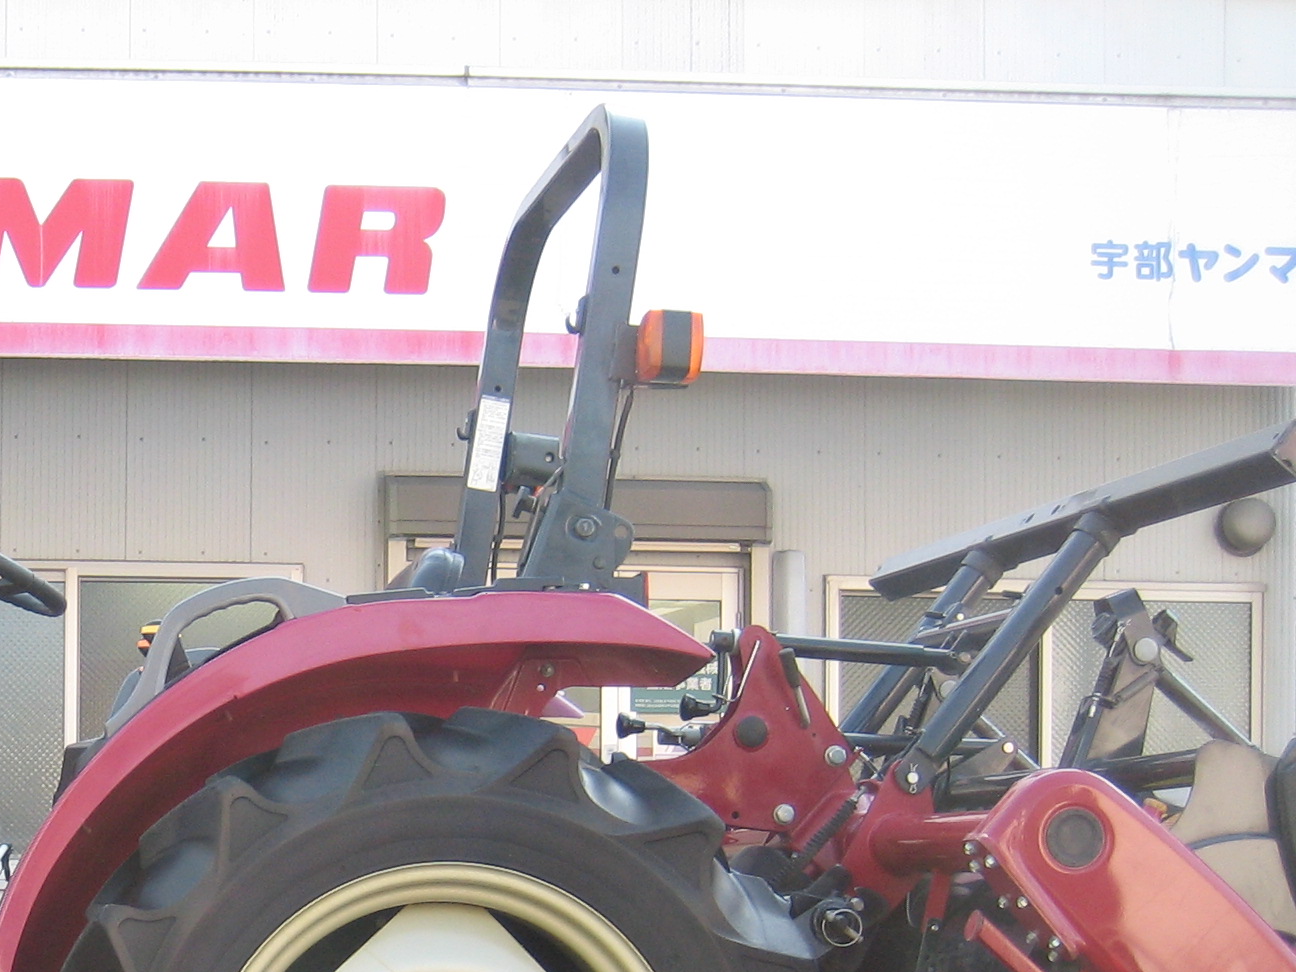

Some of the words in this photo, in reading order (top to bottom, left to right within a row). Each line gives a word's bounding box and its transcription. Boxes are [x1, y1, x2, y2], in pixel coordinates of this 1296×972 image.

[1090, 239, 1296, 284] 宇部ヤンマ
